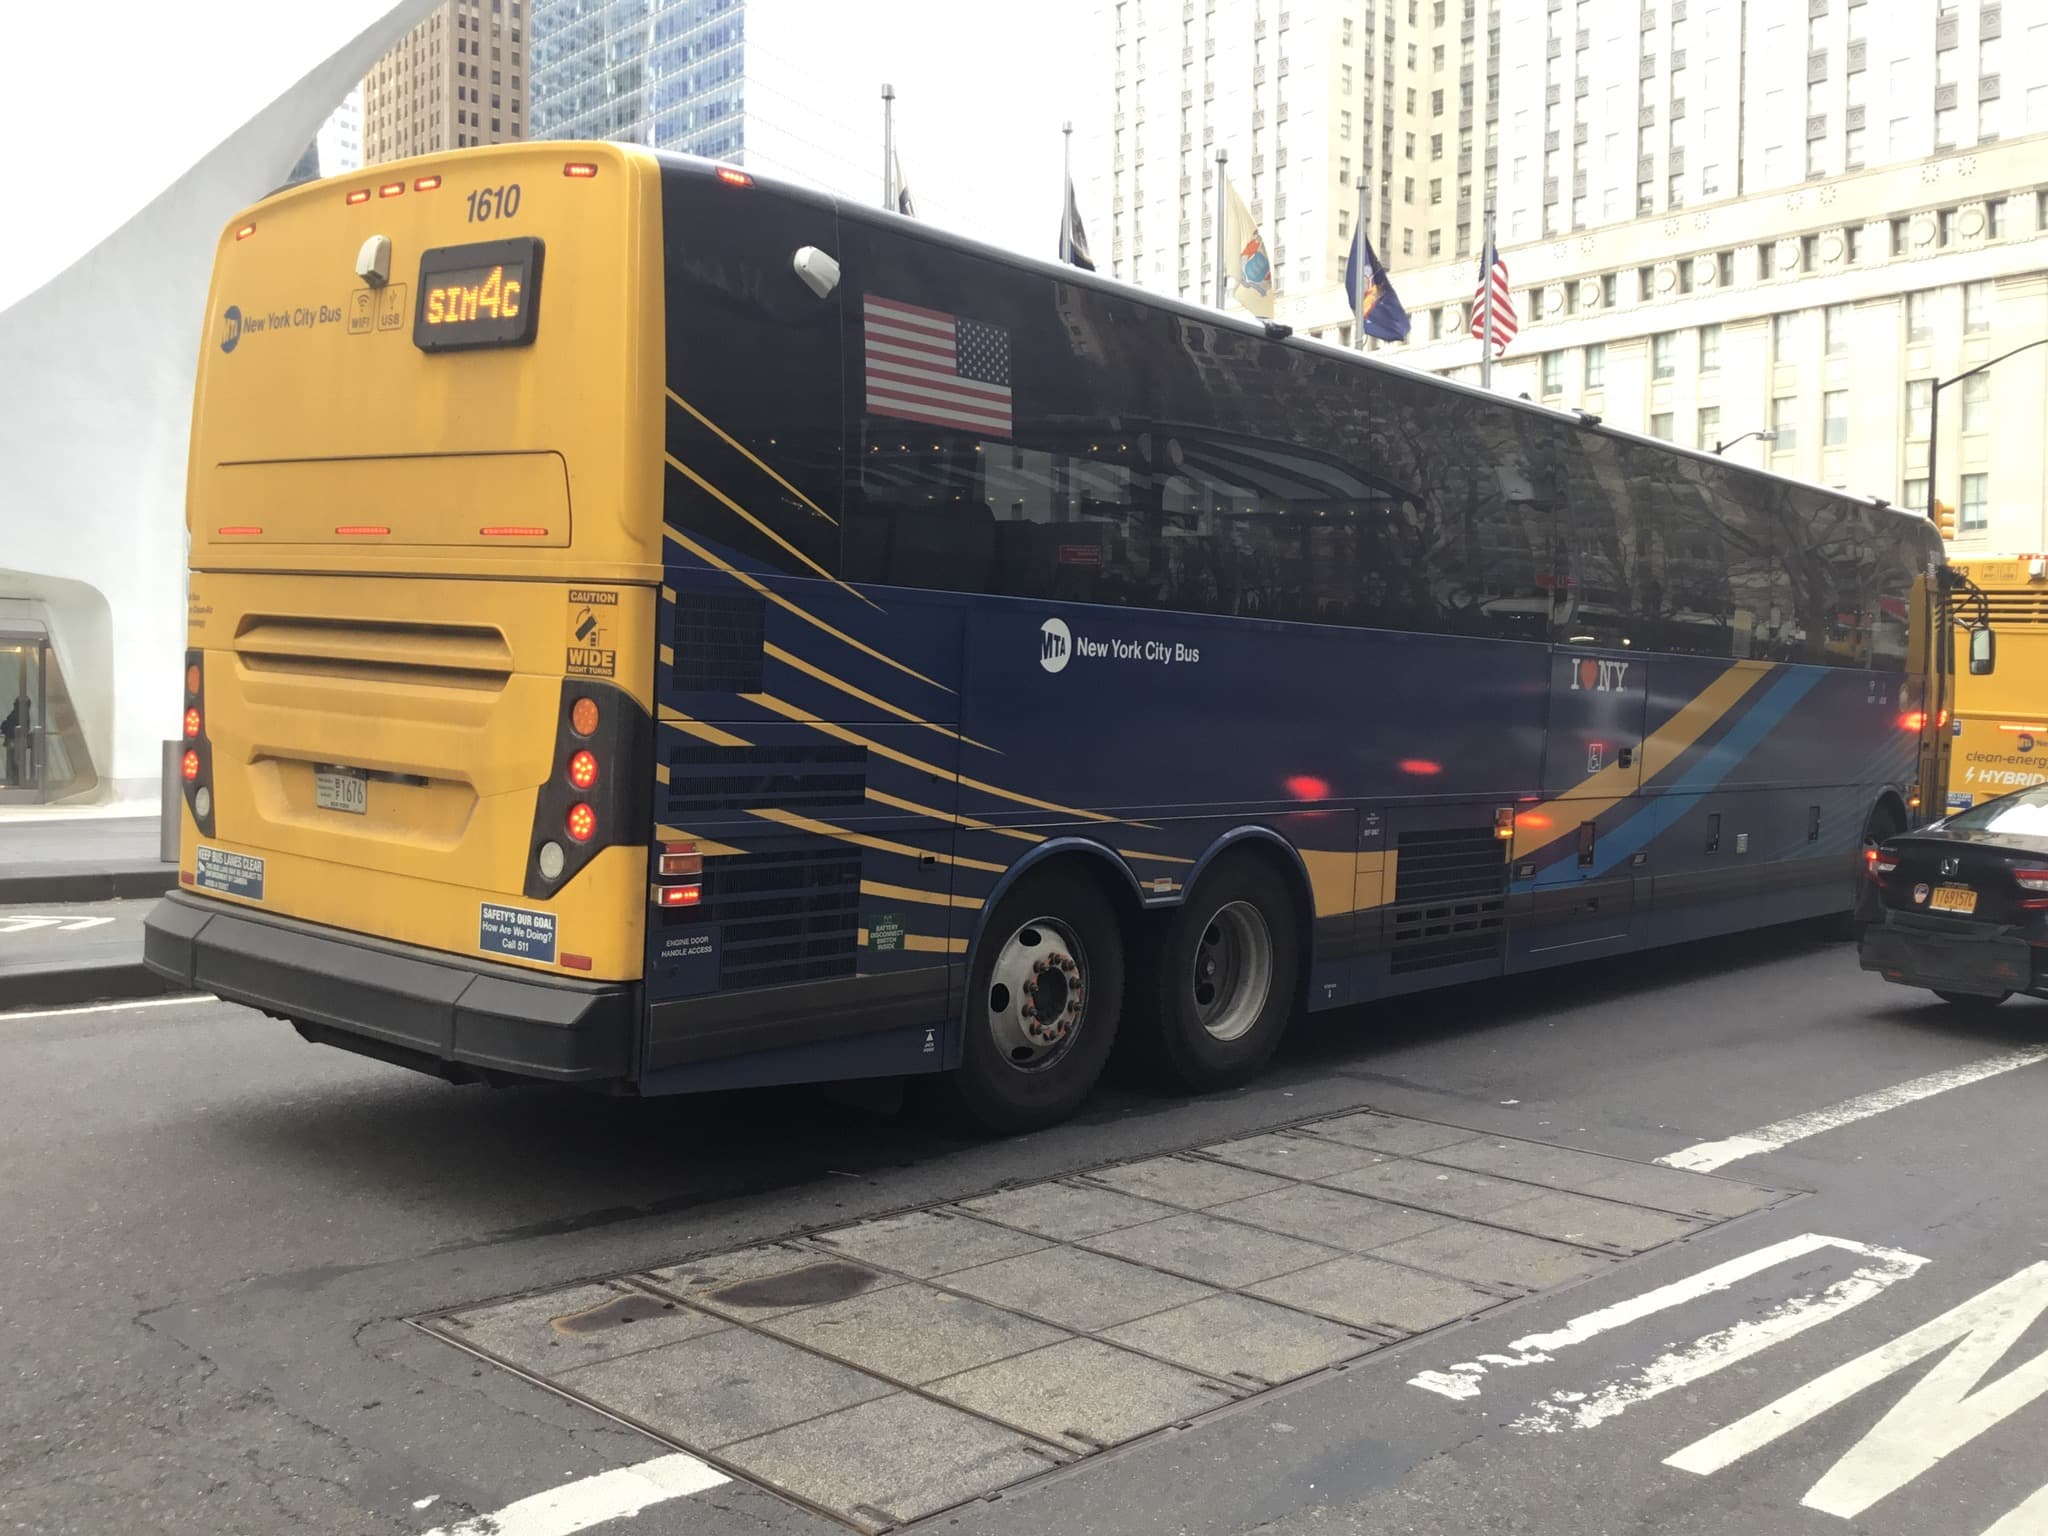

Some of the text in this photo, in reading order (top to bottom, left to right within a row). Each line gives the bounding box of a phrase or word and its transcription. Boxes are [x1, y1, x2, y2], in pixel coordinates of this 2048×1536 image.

[467, 184, 521, 223] 1610
[427, 265, 520, 323] SIM4C
[243, 305, 342, 334] New York City Bus
[381, 313, 400, 326] USB
[570, 591, 616, 604] CAUTION
[1040, 626, 1068, 663] MTA
[1077, 637, 1200, 664] New York City Bus
[569, 649, 614, 668] WIDE
[568, 665, 613, 676] RIGHT TURNS
[1571, 658, 1629, 691] I NY
[1966, 752, 2048, 769] clean-energ
[1979, 769, 2046, 786] HYBRID
[223, 853, 242, 869] LANES
[243, 857, 262, 873] CLEAR
[483, 907, 553, 930] SAFETY'S OUR GOAL
[482, 920, 552, 944] How Are We Doing?
[666, 936, 709, 947] ENGINE DOOR
[502, 938, 529, 952] Call 511
[661, 945, 713, 958] HANDLE ACCESS
